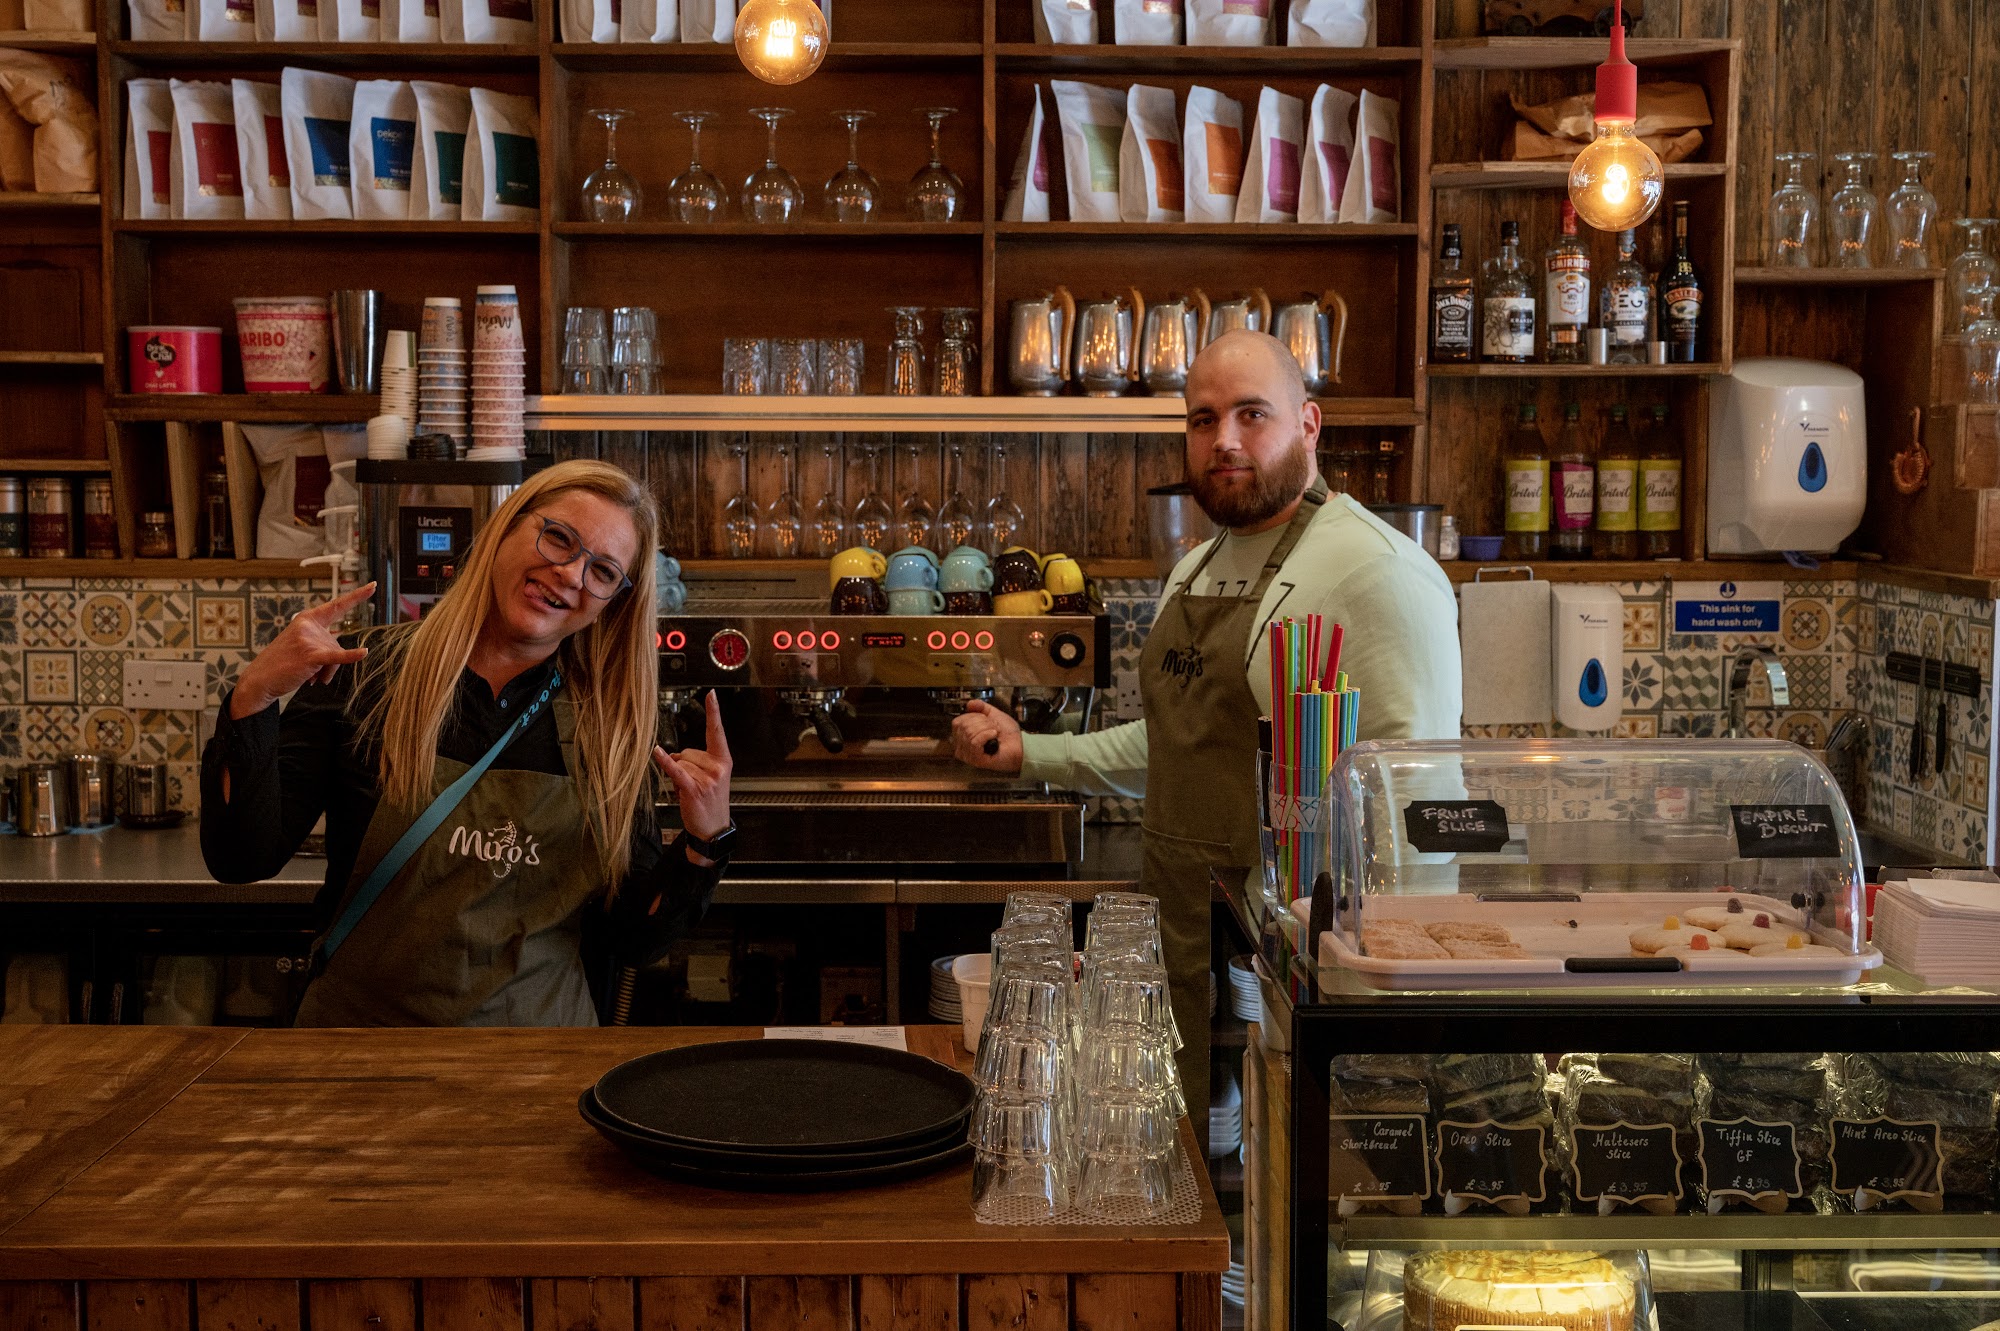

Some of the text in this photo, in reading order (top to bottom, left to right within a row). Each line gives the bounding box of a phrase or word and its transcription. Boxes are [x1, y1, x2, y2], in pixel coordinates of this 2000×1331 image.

[1551, 258, 1590, 268] SMIRNOFF
[417, 516, 453, 528] Lincat
[428, 542, 447, 550] Flow
[1700, 604, 1756, 613] This sink for
[1692, 618, 1763, 628] hand wash only
[1421, 807, 1478, 820] FRUIT
[1740, 809, 1808, 825] EMPIRE
[1437, 820, 1486, 833] SLICE
[1759, 822, 1828, 838] BISCUIT
[448, 825, 540, 866] Miro's
[1373, 1121, 1414, 1137] Caramel
[1841, 1125, 1867, 1139] Mint
[1901, 1129, 1927, 1143] Slice
[1340, 1138, 1398, 1150] Shortbread
[1450, 1131, 1512, 1147] Oreo Slice
[1715, 1128, 1781, 1147] Tiffin Slice
[1736, 1149, 1753, 1162] GF
